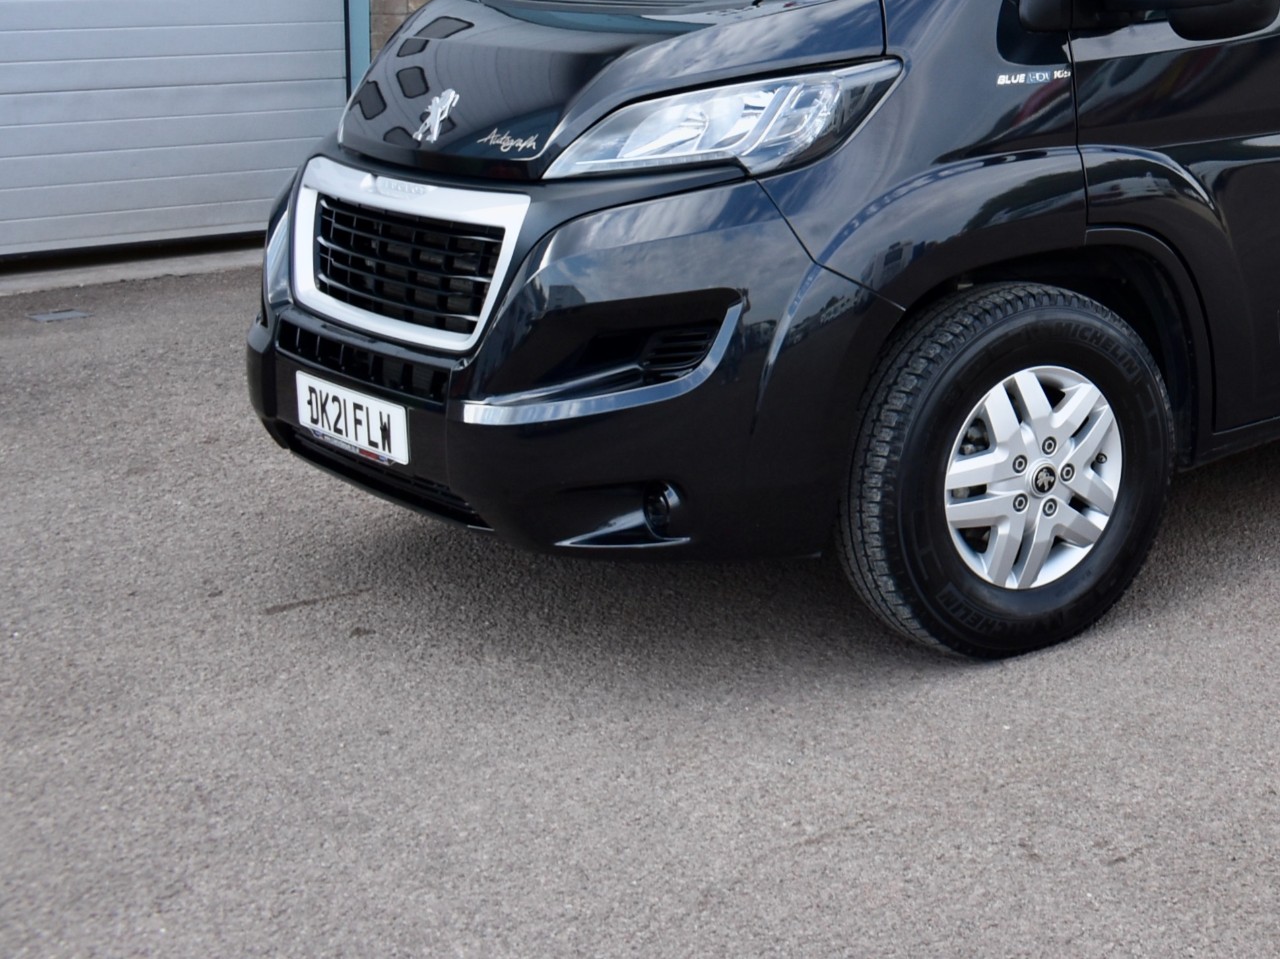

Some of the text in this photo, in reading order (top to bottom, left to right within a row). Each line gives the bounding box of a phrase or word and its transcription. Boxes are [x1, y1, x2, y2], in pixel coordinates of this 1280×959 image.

[997, 74, 1026, 85] BLUE
[476, 127, 539, 153] Autograph
[307, 385, 349, 438] DK21
[352, 402, 392, 454] FLW
